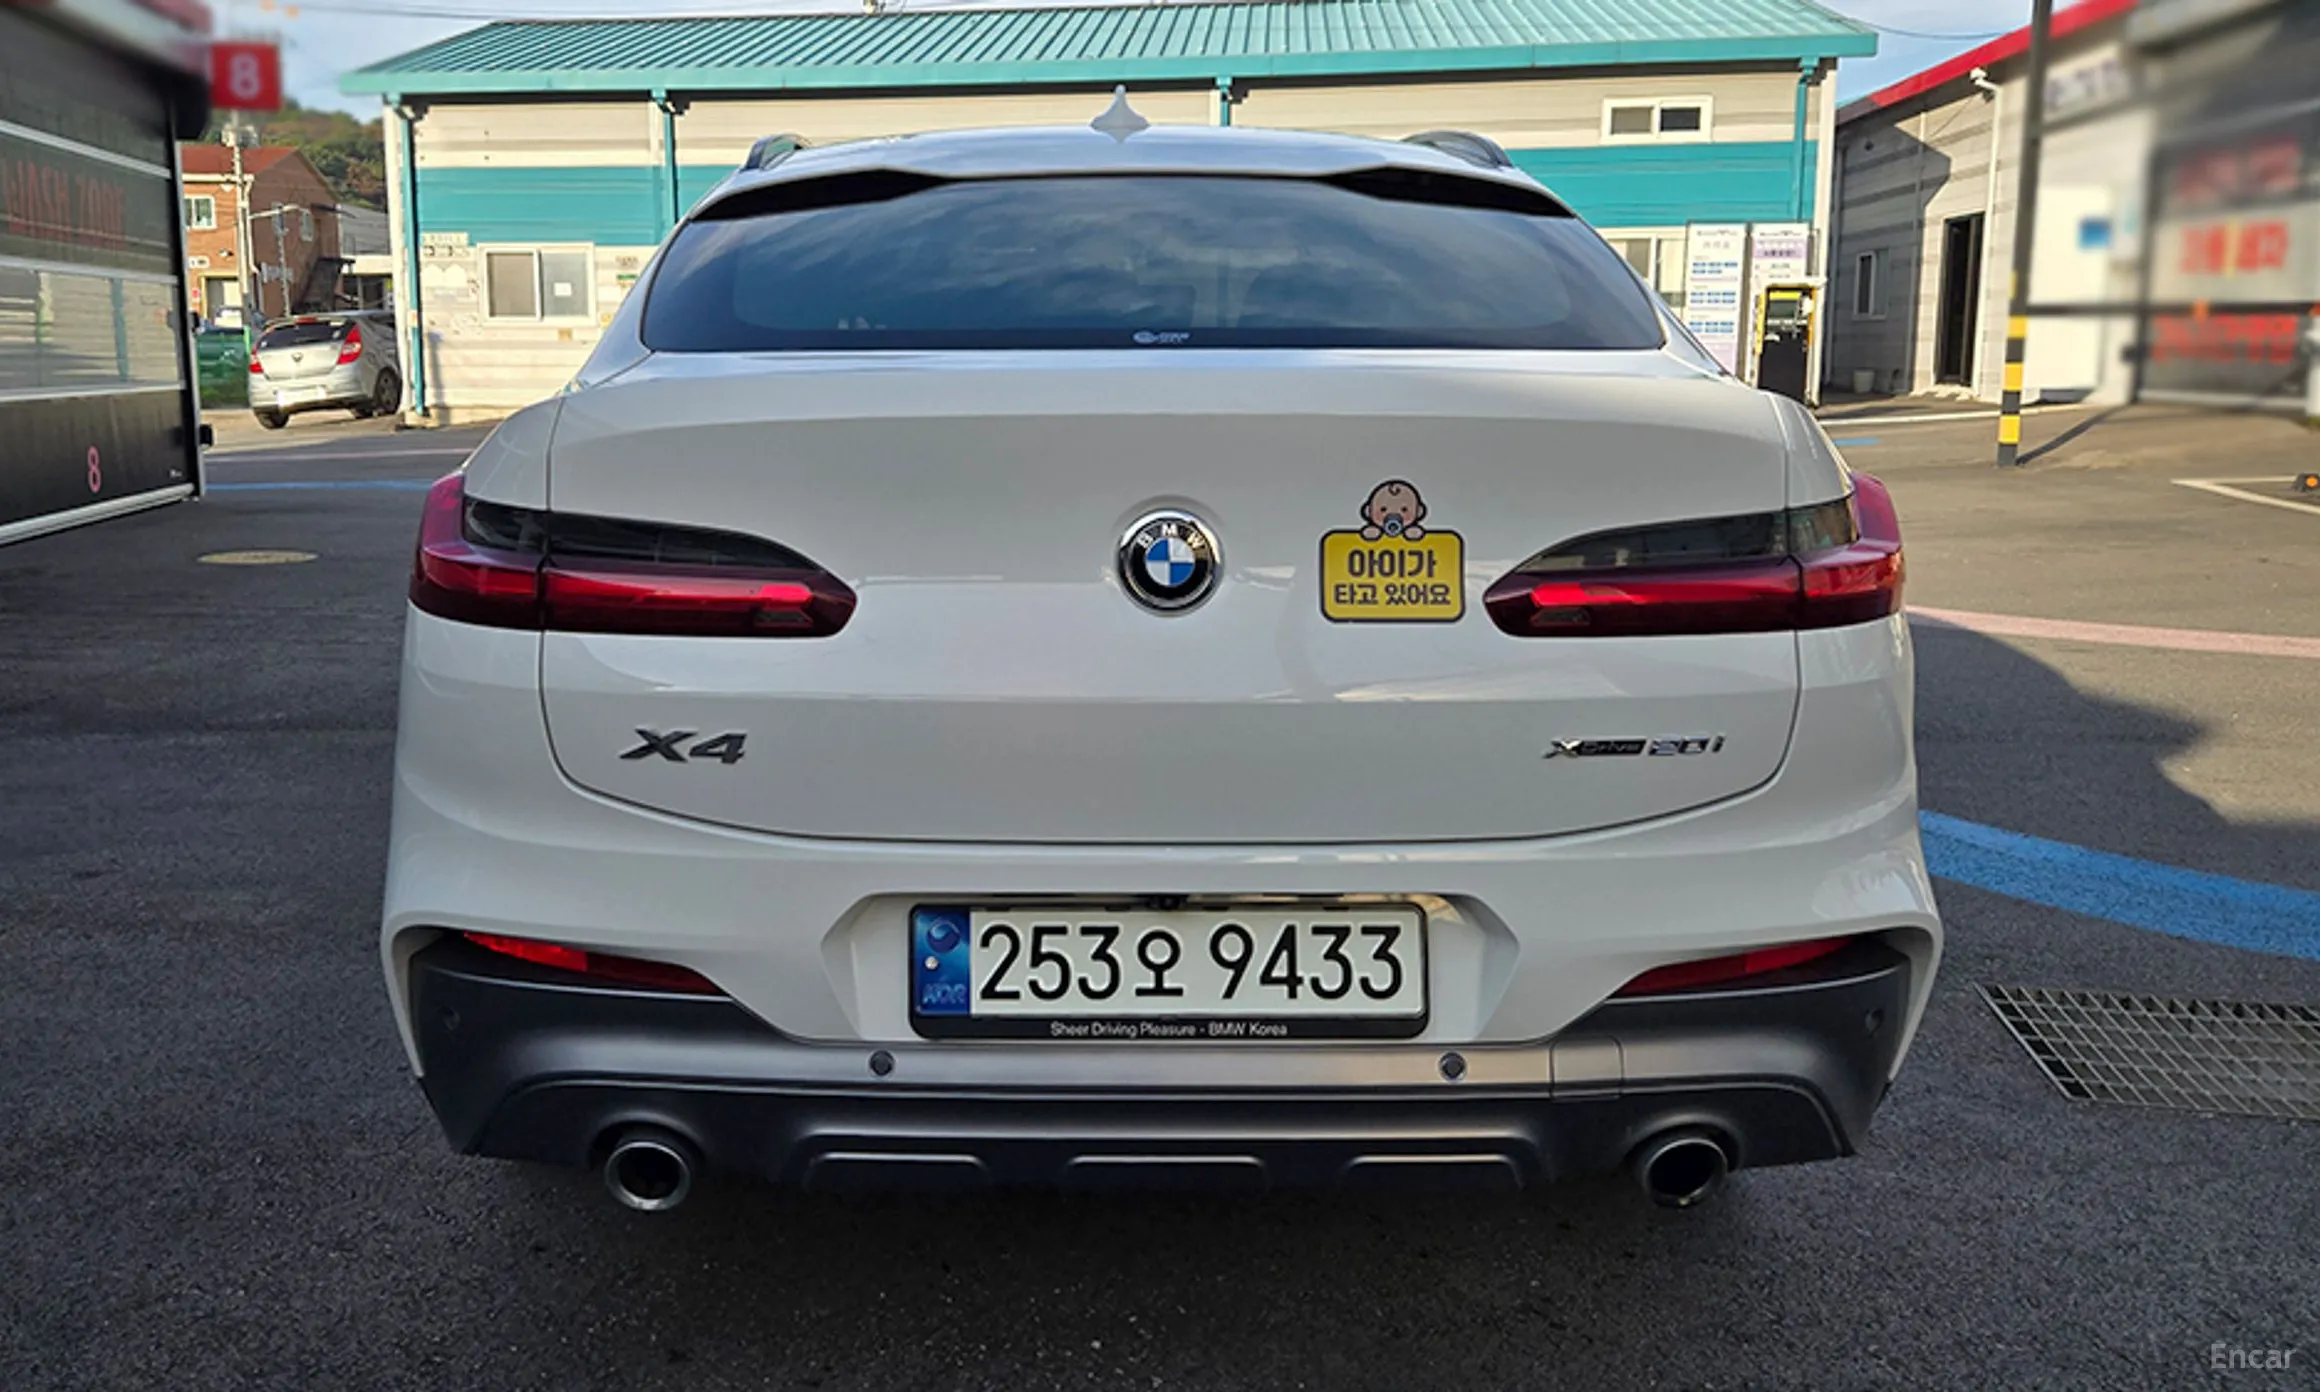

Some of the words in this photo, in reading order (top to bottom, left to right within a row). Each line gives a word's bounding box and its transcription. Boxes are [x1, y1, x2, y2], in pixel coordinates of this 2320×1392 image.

[229, 52, 261, 99] 8
[87, 445, 101, 493] 8
[1136, 522, 1207, 549] BMW
[1348, 549, 1437, 578] 아이가
[1334, 583, 1378, 605] 타고
[1384, 583, 1452, 606] 있어요
[618, 728, 748, 765] X4
[979, 923, 1184, 1000] 253오
[1208, 923, 1402, 1000] 9433
[1050, 1021, 1089, 1036] Sheer
[1091, 1021, 1137, 1038] Driving
[1140, 1021, 1197, 1036] Pleasure
[1208, 1021, 1246, 1036] BMW
[1249, 1021, 1288, 1036] Korea
